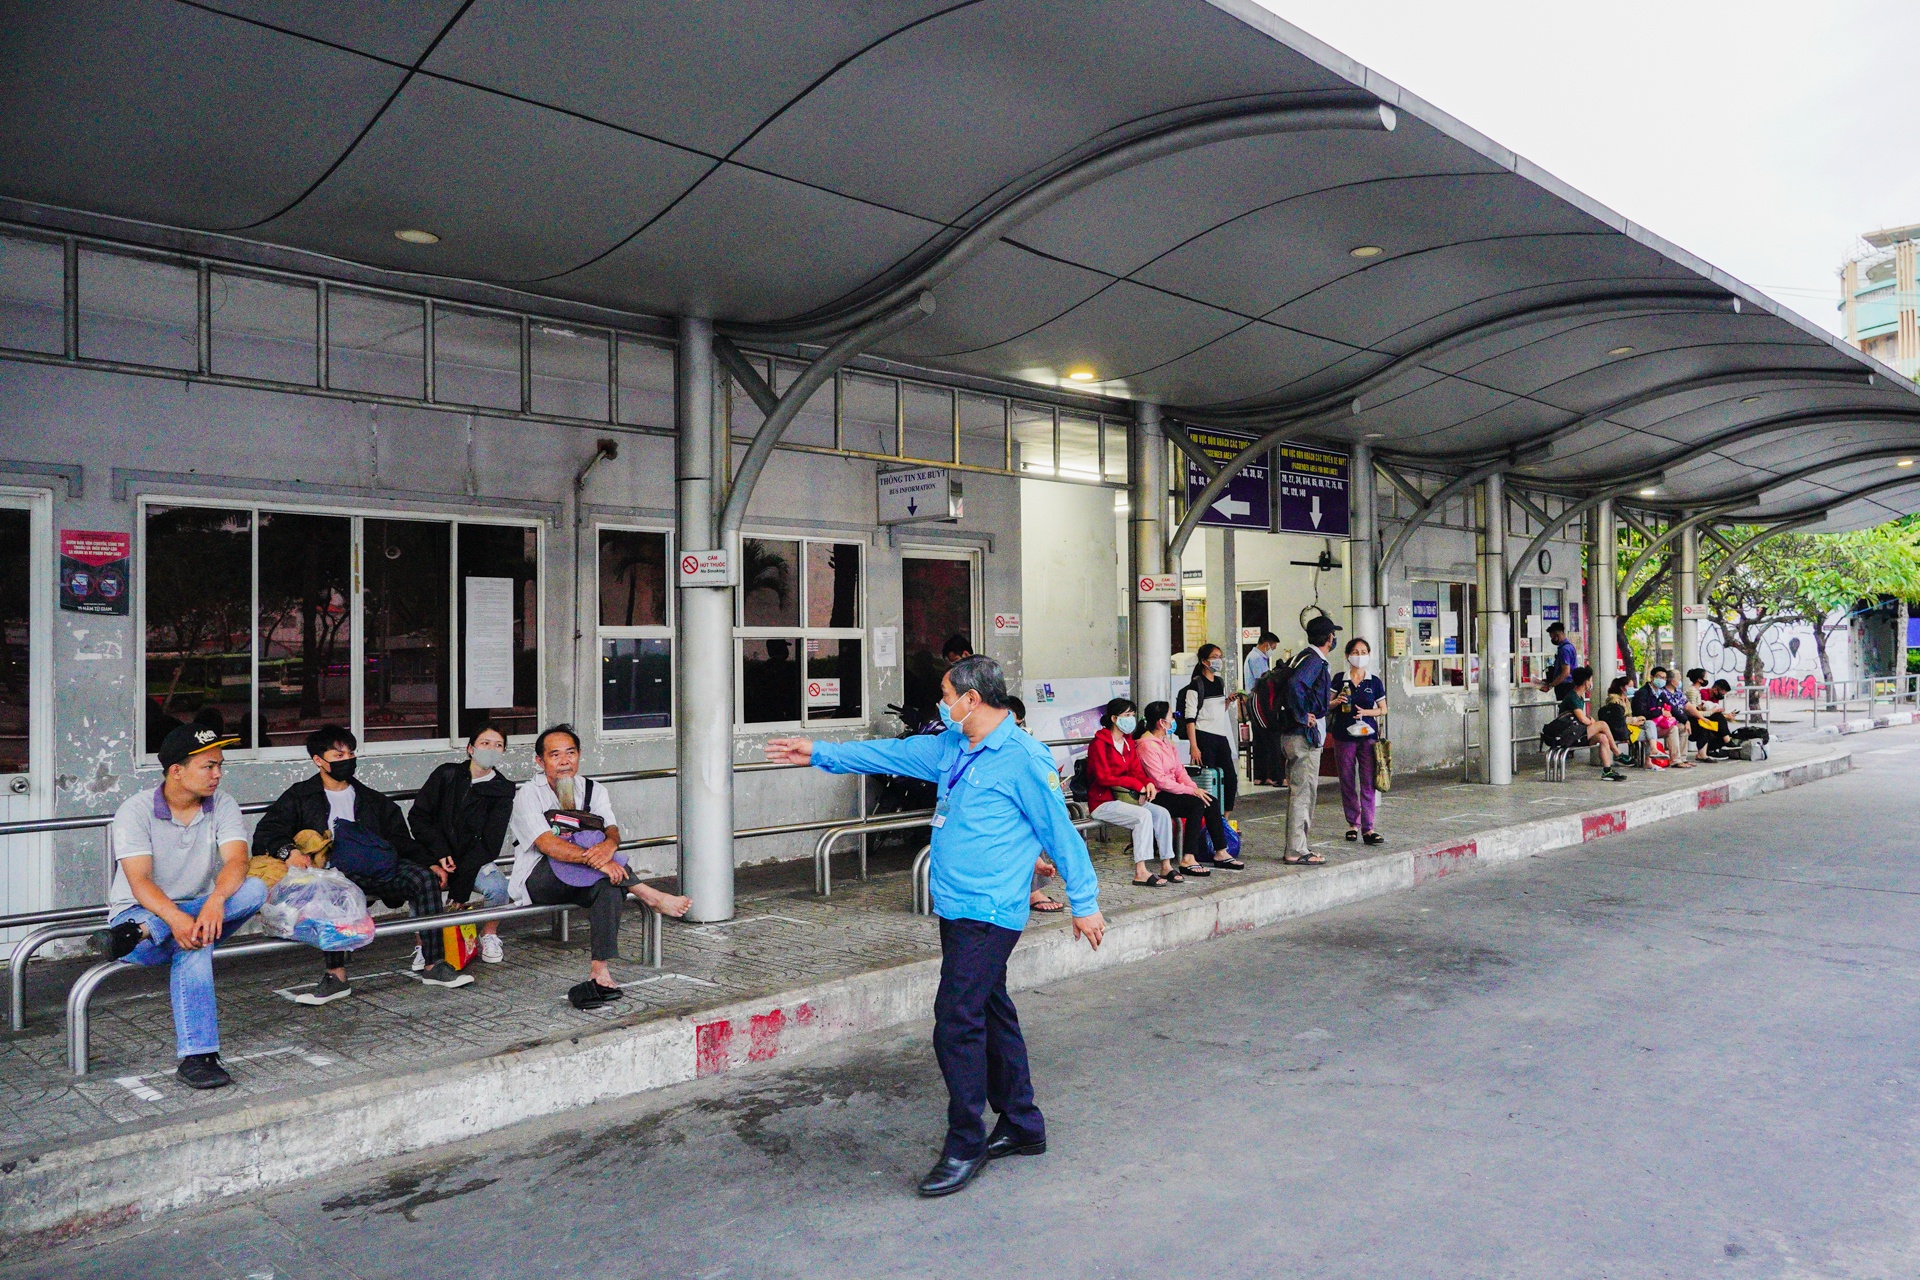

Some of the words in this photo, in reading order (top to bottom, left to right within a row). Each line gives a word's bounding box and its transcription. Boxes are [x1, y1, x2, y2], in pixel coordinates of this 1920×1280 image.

[1217, 437, 1229, 447] KHÁCH
[1230, 439, 1238, 448] CÁC
[1239, 440, 1251, 449] TUYẾ
[880, 474, 903, 485] THÔNG
[904, 473, 916, 482] TIN
[917, 472, 926, 480] XE
[900, 483, 936, 494] INFORMATION
